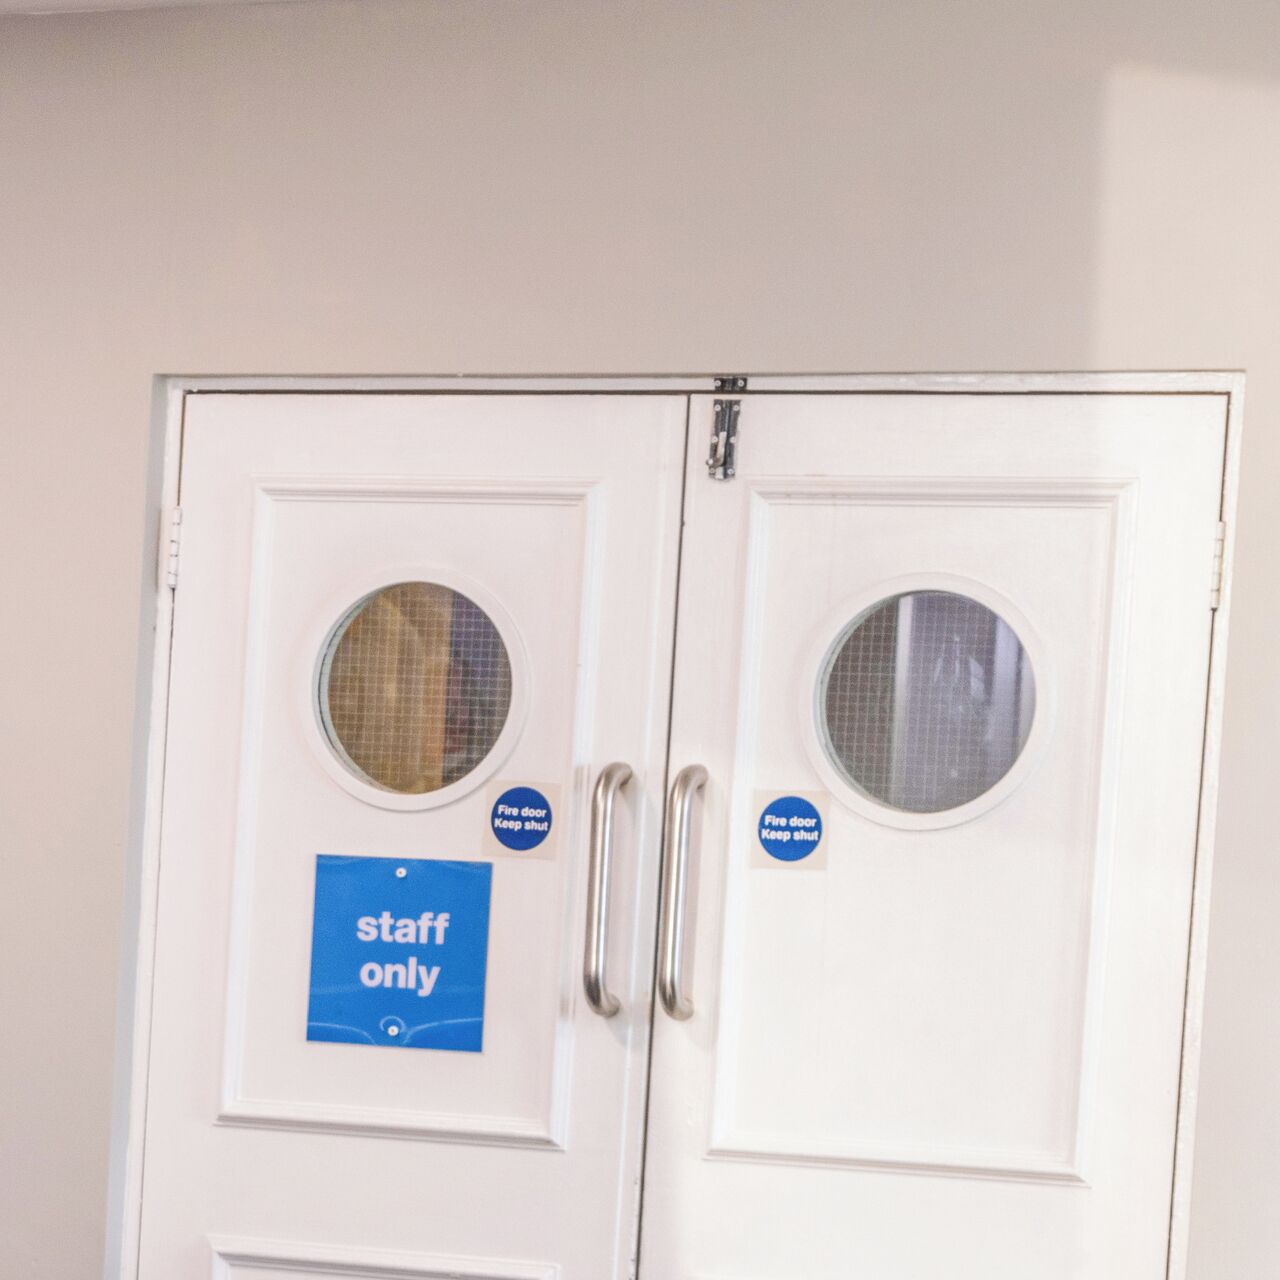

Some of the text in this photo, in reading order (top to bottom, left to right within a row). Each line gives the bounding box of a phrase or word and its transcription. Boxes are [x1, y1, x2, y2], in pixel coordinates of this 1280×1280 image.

[498, 804, 547, 817] Fire door
[494, 817, 548, 832] Keep shut
[764, 815, 817, 828] Fire door
[761, 828, 819, 842] Keep shut
[356, 911, 450, 945] staff
[359, 956, 441, 997] only
